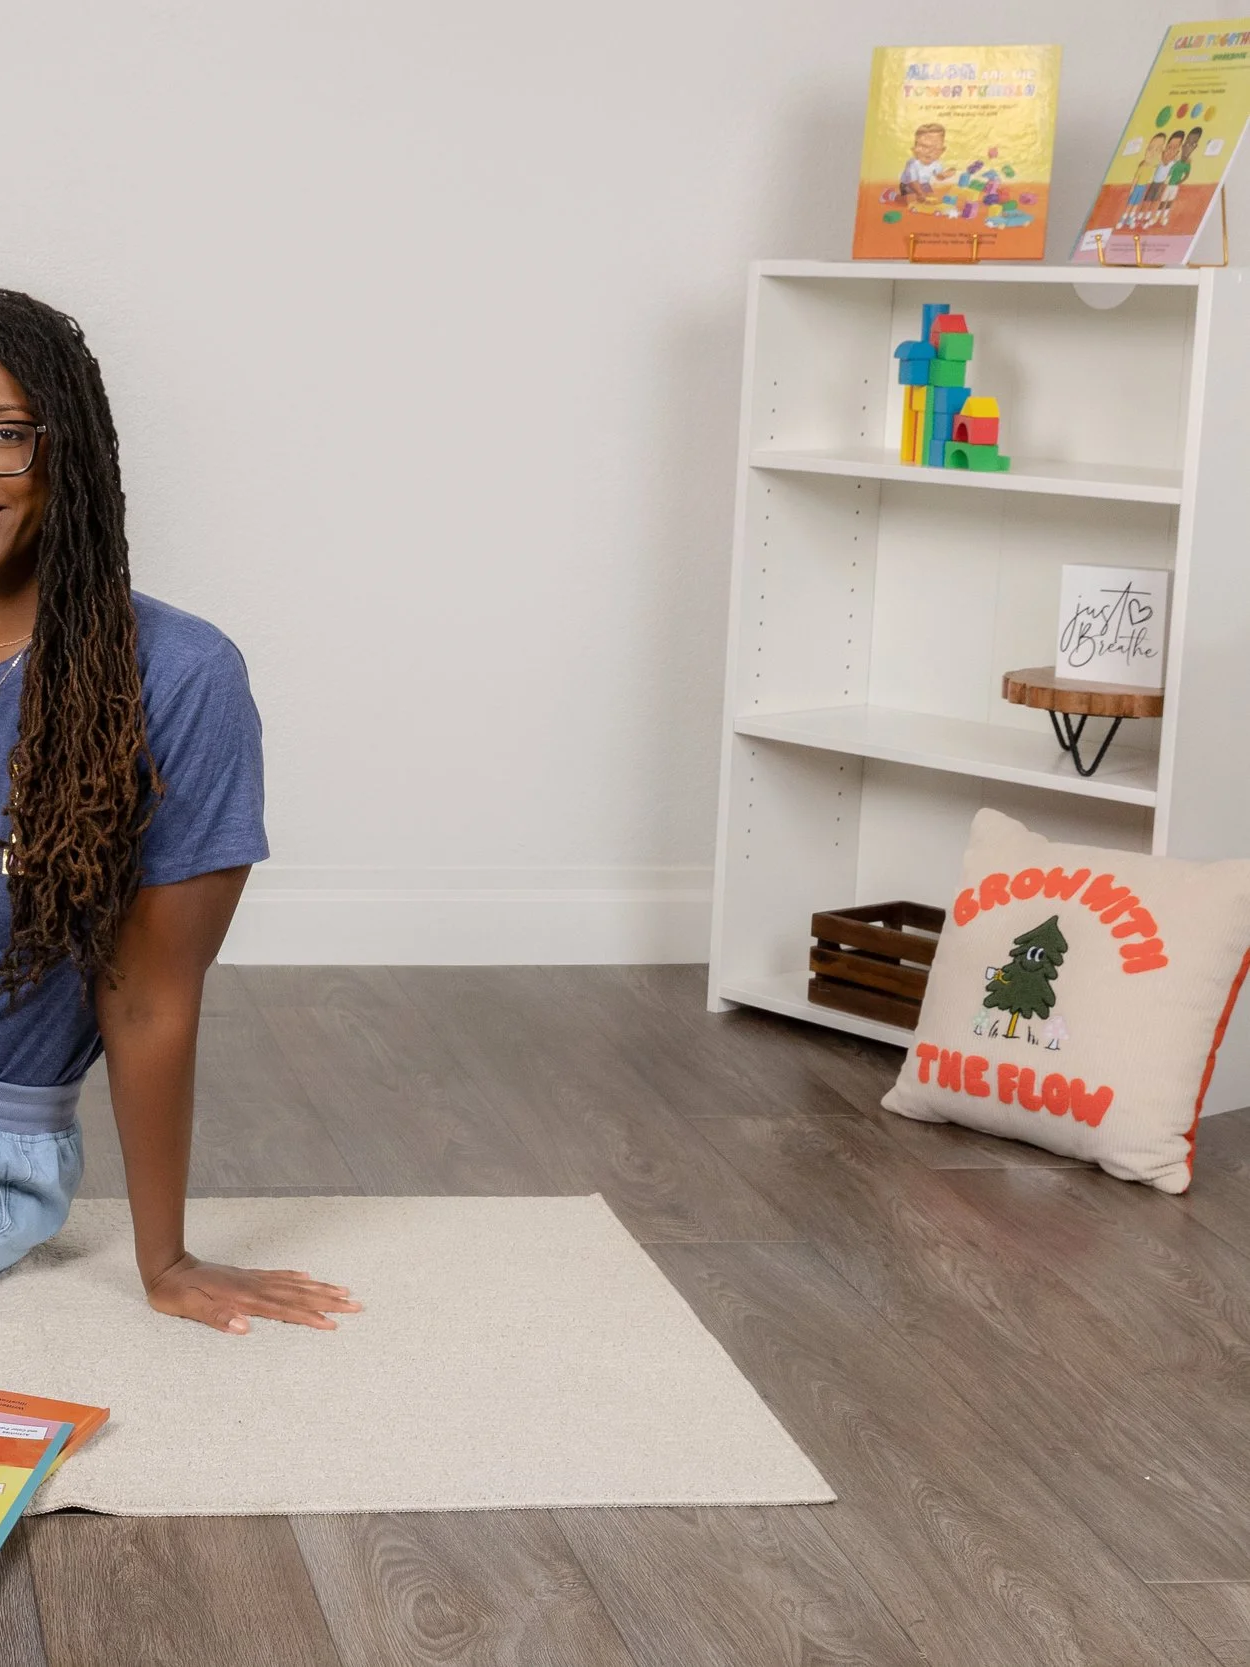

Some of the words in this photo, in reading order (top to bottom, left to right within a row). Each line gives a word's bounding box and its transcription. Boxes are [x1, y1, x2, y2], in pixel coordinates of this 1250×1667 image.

[1068, 621, 1159, 667] Breathe
[953, 867, 1091, 927] GROW
[1080, 874, 1169, 974] WITH
[916, 1042, 991, 1098] THE
[997, 1063, 1114, 1128] FLOW
